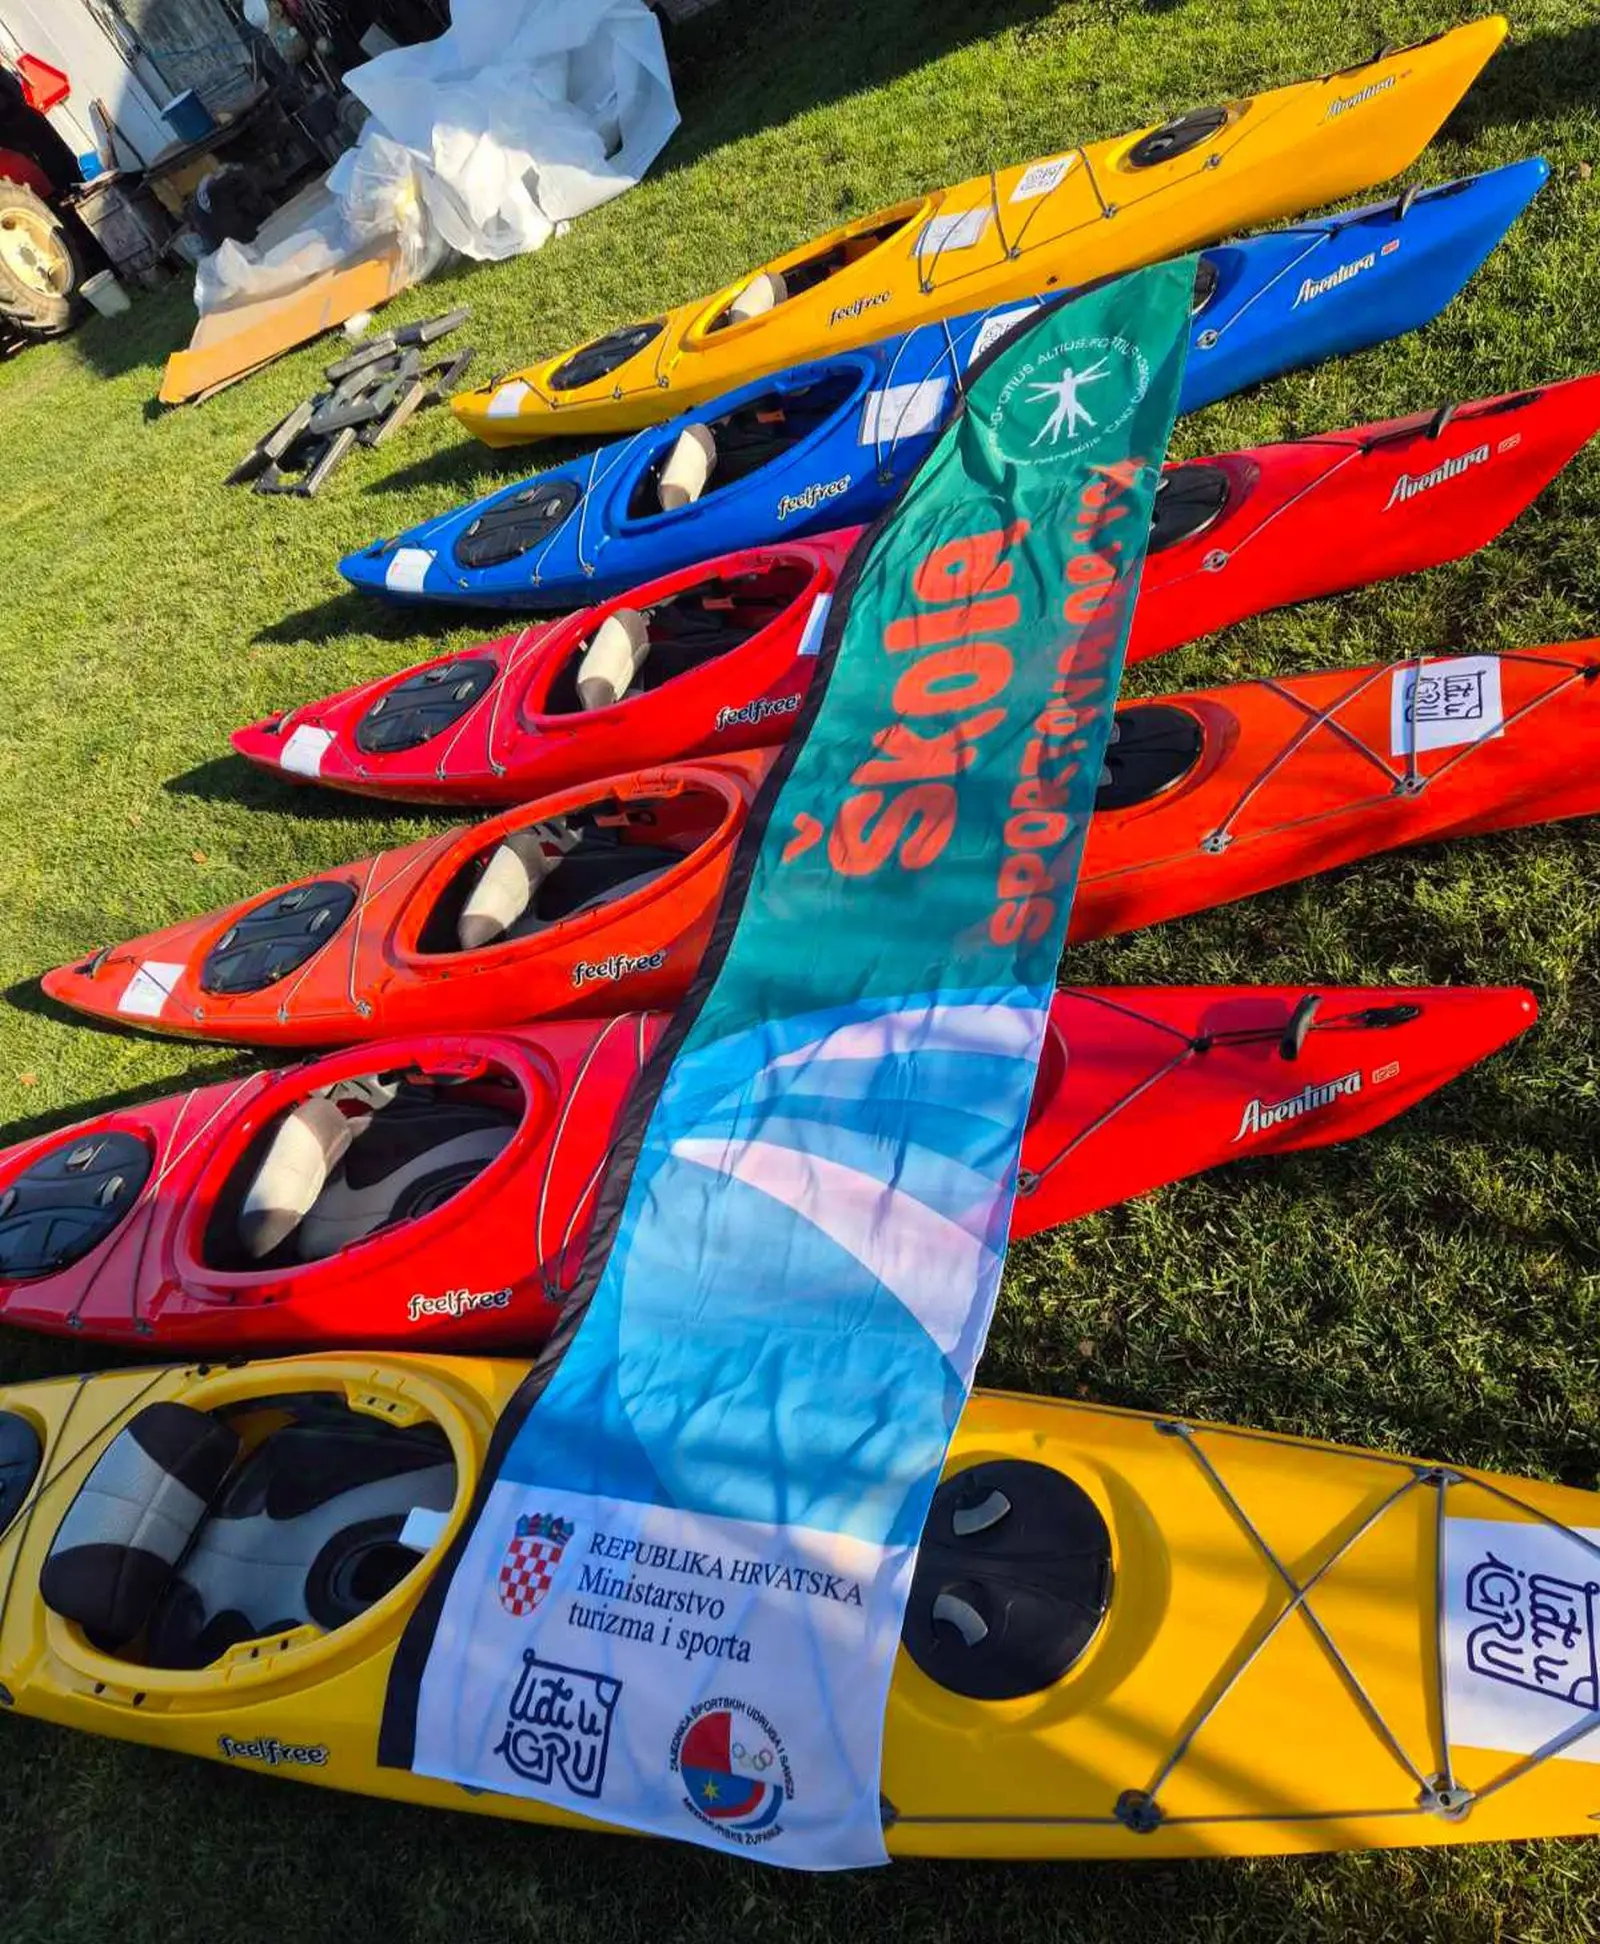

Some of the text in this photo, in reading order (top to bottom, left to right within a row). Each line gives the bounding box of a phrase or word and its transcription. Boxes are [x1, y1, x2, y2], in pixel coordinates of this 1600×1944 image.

[1291, 253, 1376, 310] Aventura
[777, 475, 851, 520] feelfree
[1382, 443, 1490, 512] Aventura
[715, 693, 801, 732] feelfree
[572, 949, 666, 988] feelfree
[1230, 1070, 1362, 1142] Aventura
[407, 1288, 512, 1321] feelfree
[577, 1564, 725, 1620] Ministarstvo
[589, 1532, 863, 1606] REPUBLIKA HRVATSKA
[568, 1600, 752, 1663] turizma i sporta
[577, 1700, 602, 1737] u
[219, 1736, 329, 1766] feelfree
